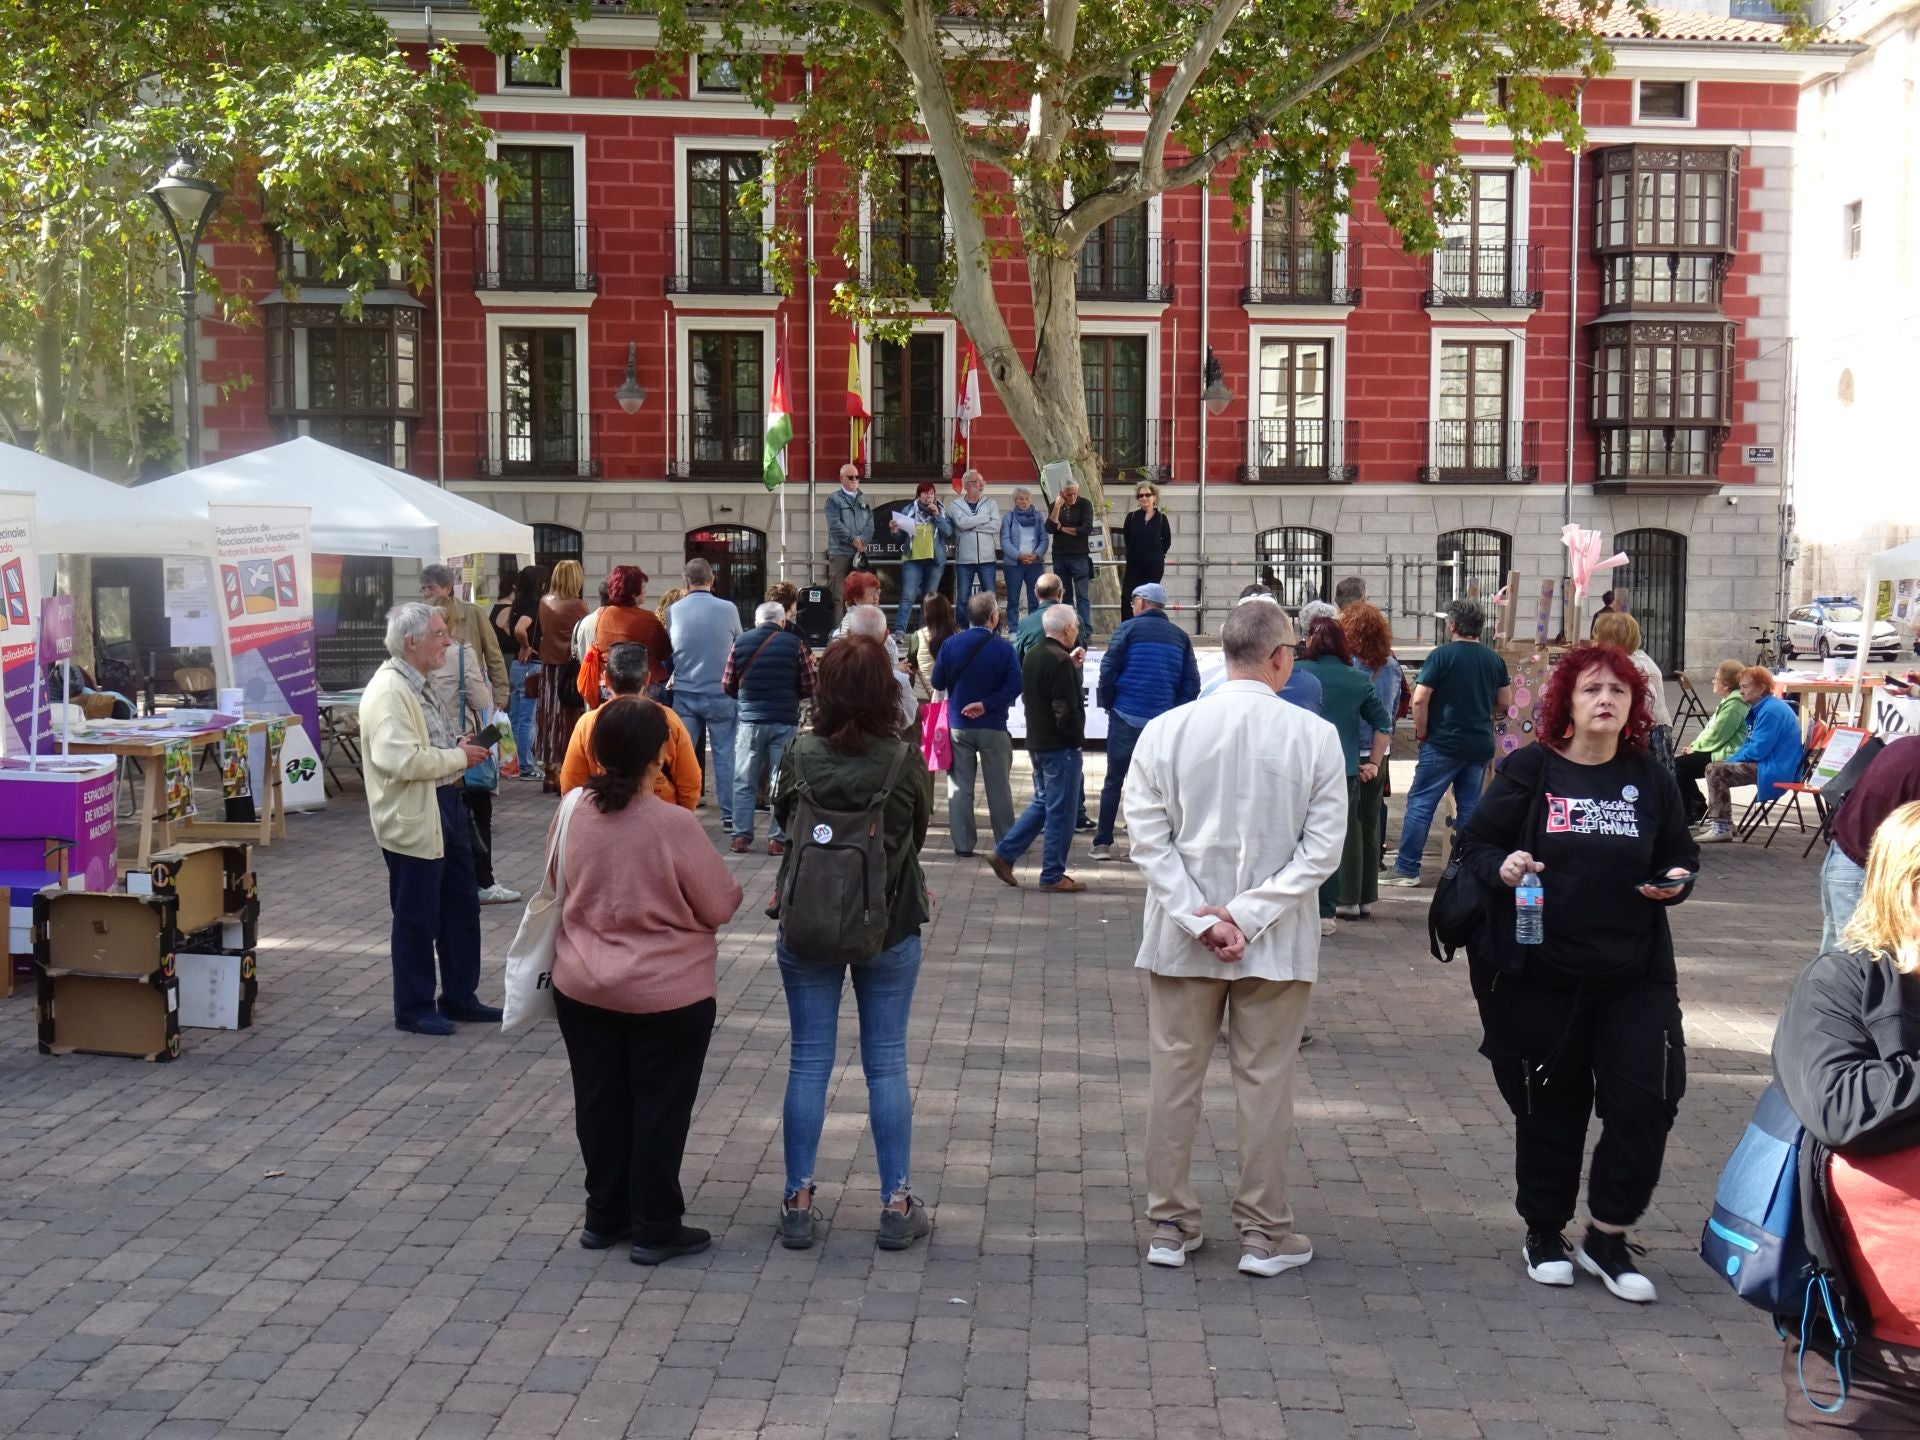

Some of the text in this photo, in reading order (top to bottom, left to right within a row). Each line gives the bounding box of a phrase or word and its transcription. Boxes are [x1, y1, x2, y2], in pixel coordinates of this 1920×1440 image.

[216, 523, 270, 535] Federación de
[216, 531, 301, 546] Asociaciones Vecinales
[218, 543, 286, 557] Antonio Machado
[887, 544, 899, 552] EL
[84, 786, 105, 805] ESPACIO
[85, 810, 93, 824] DE
[89, 820, 111, 840] MACHISTA
